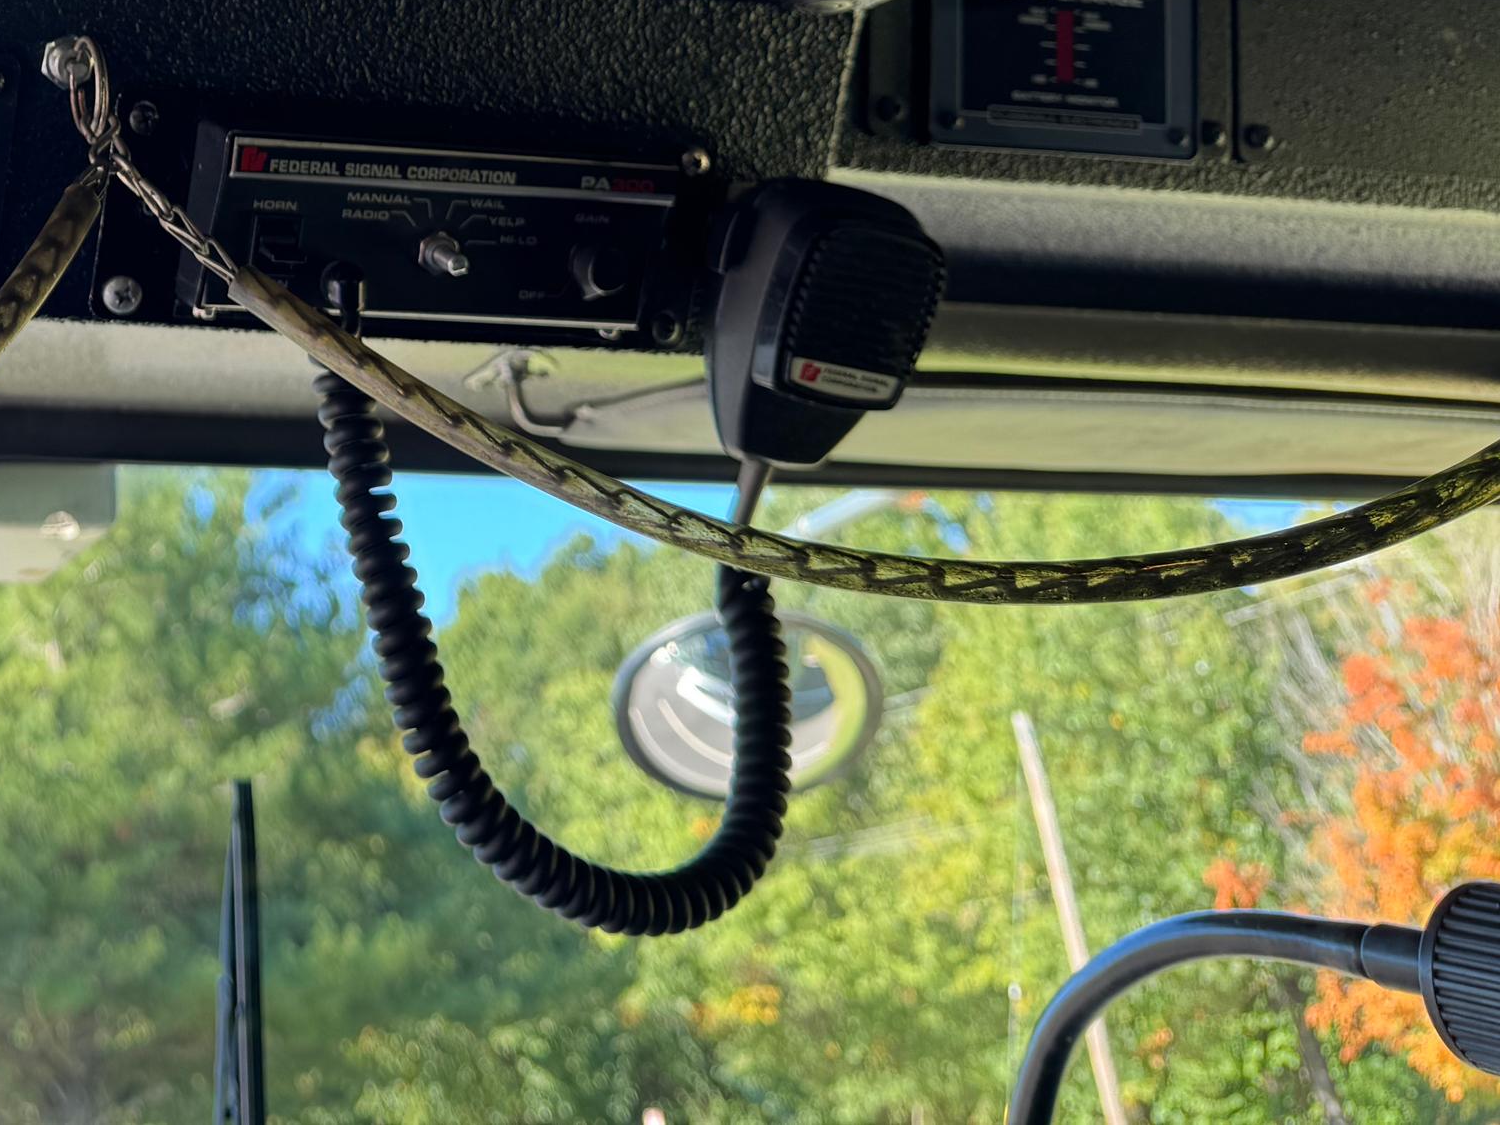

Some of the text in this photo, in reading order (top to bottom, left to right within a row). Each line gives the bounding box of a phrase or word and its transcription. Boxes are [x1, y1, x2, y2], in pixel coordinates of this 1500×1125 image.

[270, 159, 517, 185] FEDERAL SIGNAL CORPORATION
[347, 191, 412, 205] MANUAL
[469, 198, 505, 210] WAIL
[253, 199, 299, 211] HORN
[342, 209, 390, 220] RADIO
[489, 216, 526, 228] YELP
